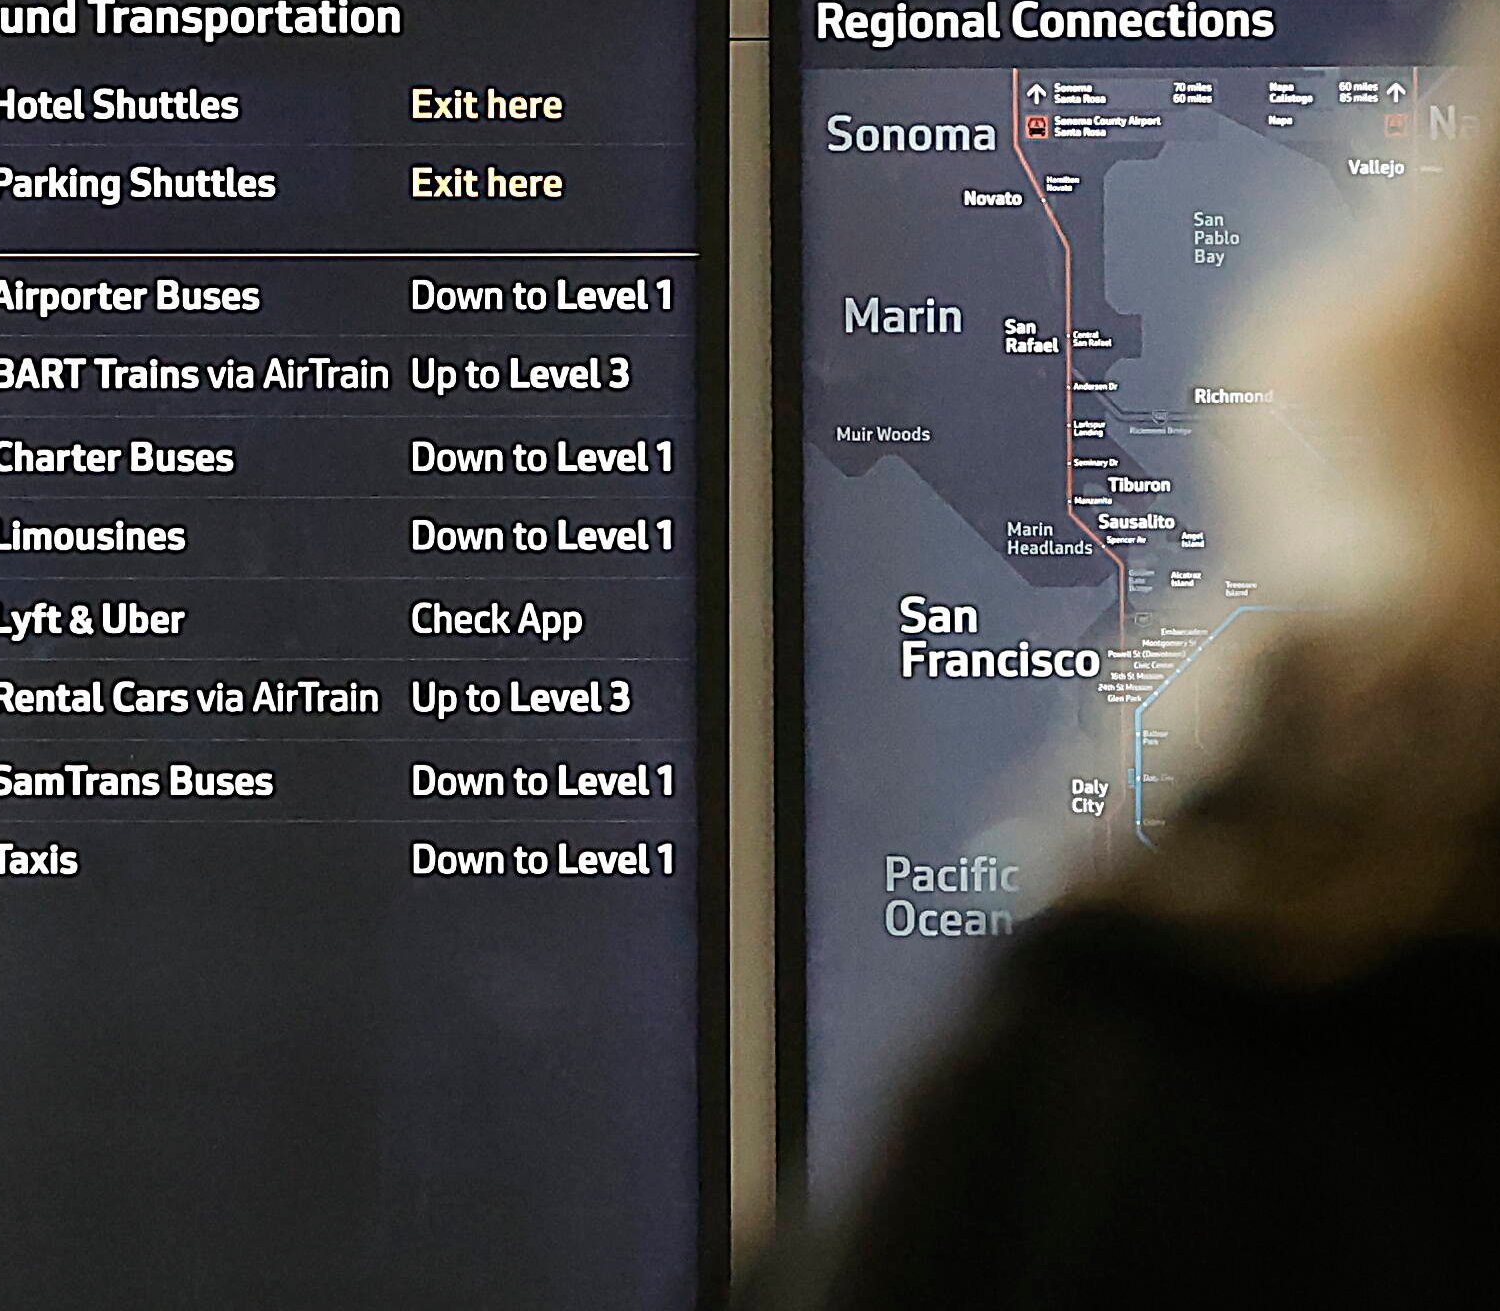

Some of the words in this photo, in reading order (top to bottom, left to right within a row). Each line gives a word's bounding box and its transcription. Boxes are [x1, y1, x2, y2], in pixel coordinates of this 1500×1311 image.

[817, 1, 1001, 48] Regional
[1012, 0, 1274, 39] Connections
[93, 87, 239, 120] Shuttles
[412, 88, 479, 119] Exit
[487, 88, 563, 119] here
[827, 114, 996, 152] Sonoma
[130, 166, 276, 198] Shuttles
[412, 167, 479, 198] Exit
[487, 166, 563, 198] here
[1348, 159, 1405, 178] Vallejo
[964, 190, 1023, 206] Novato
[1193, 211, 1224, 227] San
[1194, 229, 1240, 245] Pablo
[1194, 248, 1225, 267] Bay
[156, 279, 260, 311] Buses
[412, 279, 503, 311] Down
[512, 282, 547, 311] to
[557, 279, 649, 311] Level
[656, 279, 671, 310] 1
[845, 297, 962, 333] Marin
[1004, 318, 1037, 335] San
[1005, 337, 1060, 353] Rafael
[93, 357, 200, 389] Trains
[206, 358, 254, 389] via
[262, 357, 389, 389] AirTrain
[412, 357, 457, 396] Up
[464, 360, 500, 389] to
[510, 357, 602, 389] Level
[608, 357, 630, 389] 3
[1194, 388, 1274, 404] Richmond
[836, 426, 874, 442] Muir
[876, 426, 931, 442] Woods
[130, 441, 234, 473] Buses
[1107, 476, 1171, 493] Tiburon
[1007, 521, 1054, 537] Marin
[1098, 513, 1176, 530] Sausalito
[1007, 539, 1093, 555] Headlands
[69, 604, 95, 635] &
[102, 602, 186, 634] Uber
[411, 601, 511, 634] Check
[517, 602, 583, 642] App
[900, 595, 978, 634] San
[902, 640, 1100, 678] Francisco
[112, 680, 189, 713] Cars
[196, 682, 244, 713] via
[252, 680, 379, 713] AirTrain
[170, 764, 274, 796] Buses
[1071, 778, 1109, 800] Daly
[1071, 797, 1105, 817] City
[886, 855, 1020, 892] Pacific
[885, 899, 1010, 937] Ocean
